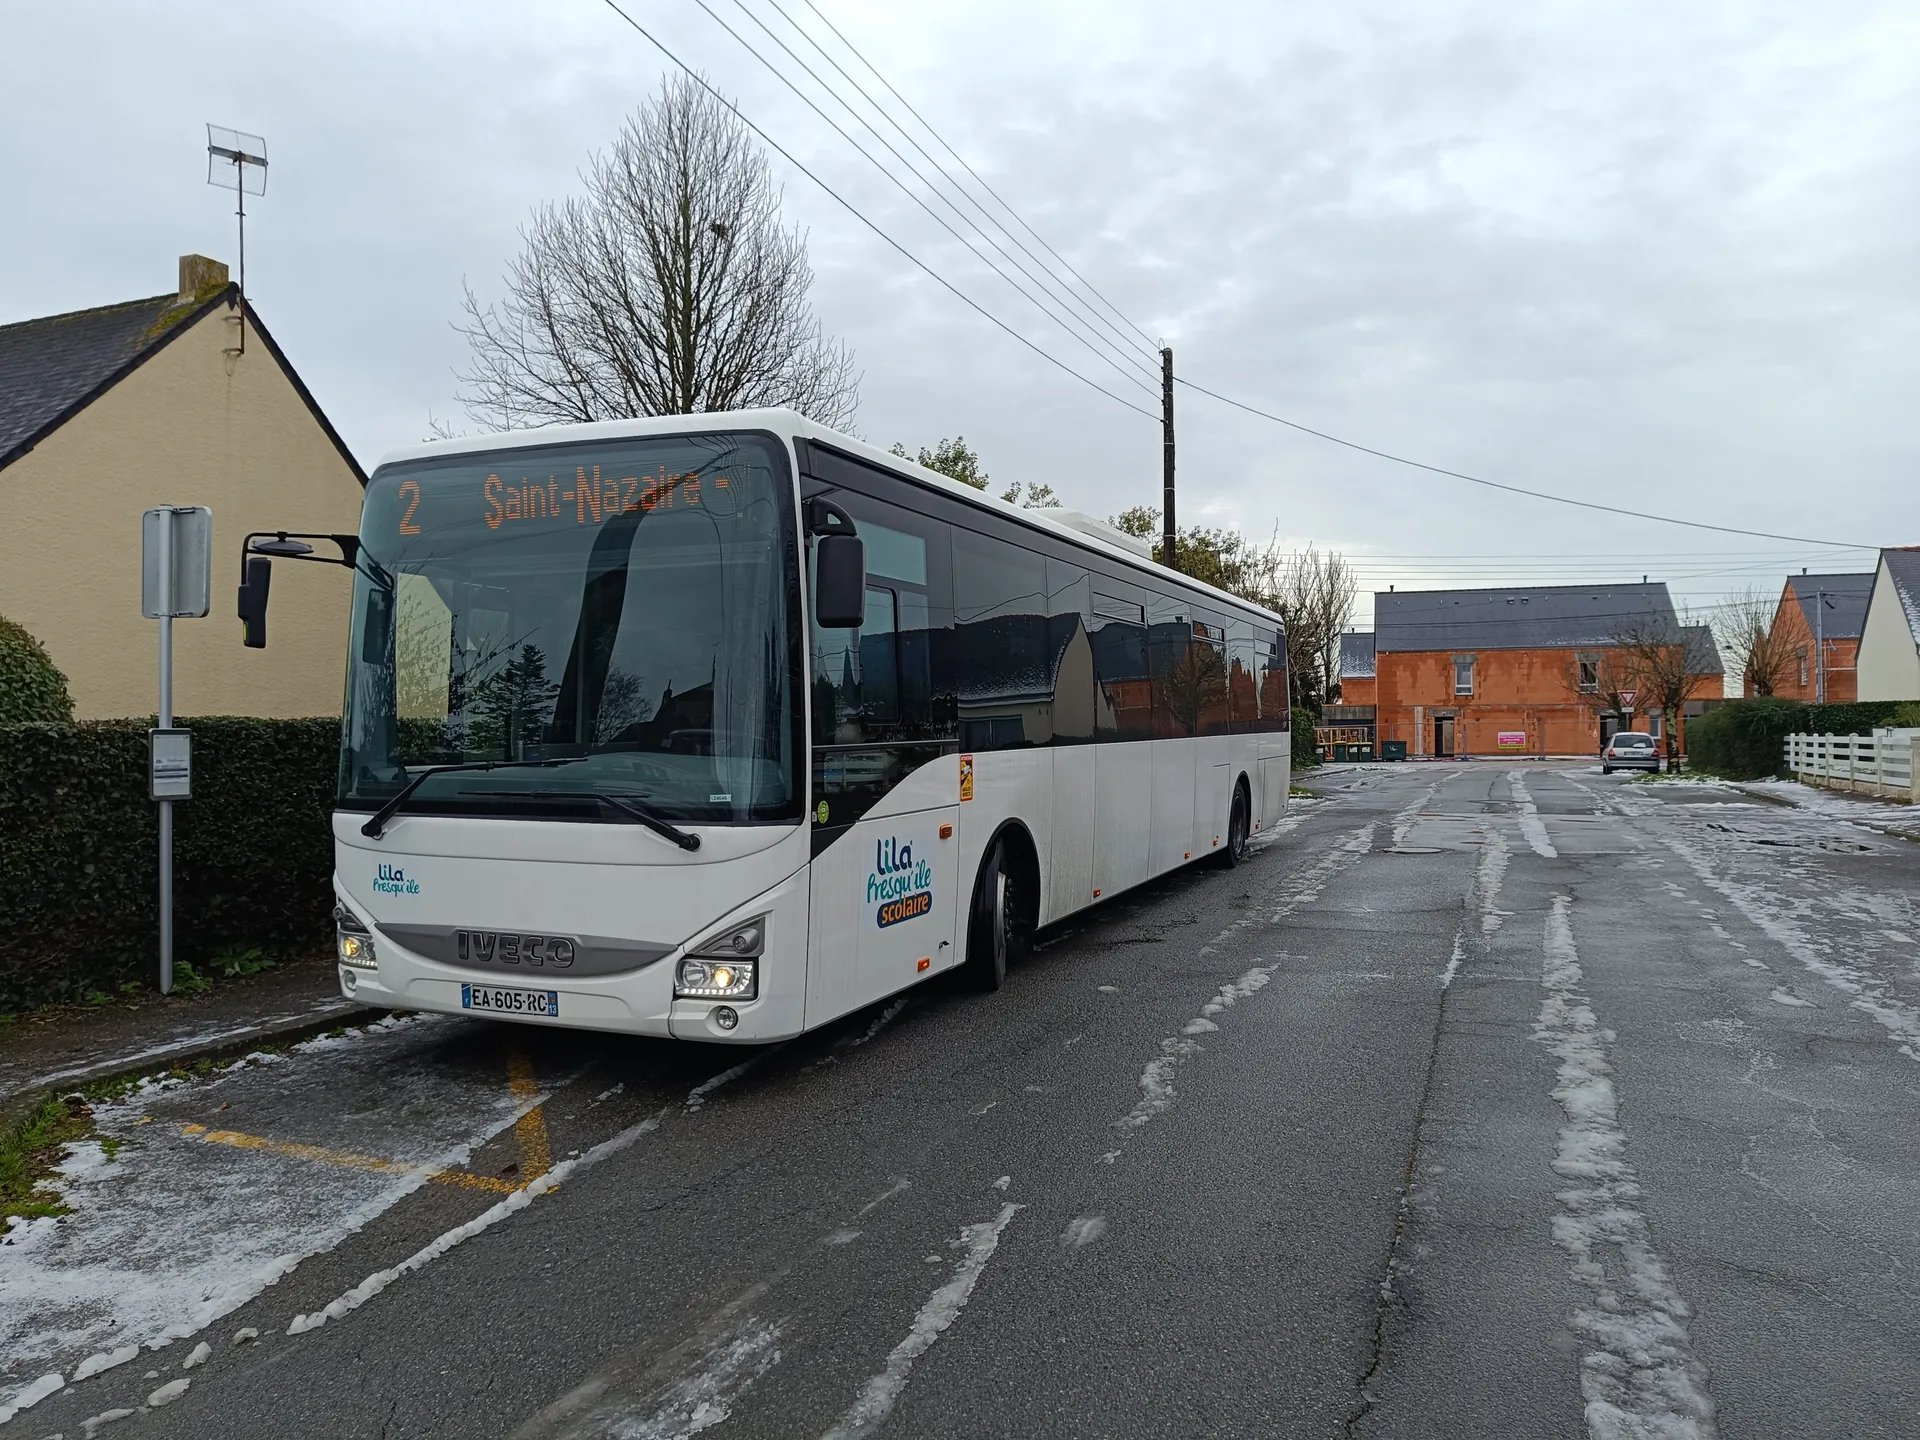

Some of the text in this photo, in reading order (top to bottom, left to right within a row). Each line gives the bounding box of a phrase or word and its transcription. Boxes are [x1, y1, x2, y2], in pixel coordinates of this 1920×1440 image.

[399, 480, 420, 535] 2
[484, 465, 700, 529] Saint-Nazaire
[881, 893, 929, 925] scolaire
[458, 931, 575, 968] IVECO
[472, 988, 547, 1012] EA-605-RC
[549, 1005, 557, 1014] 13
